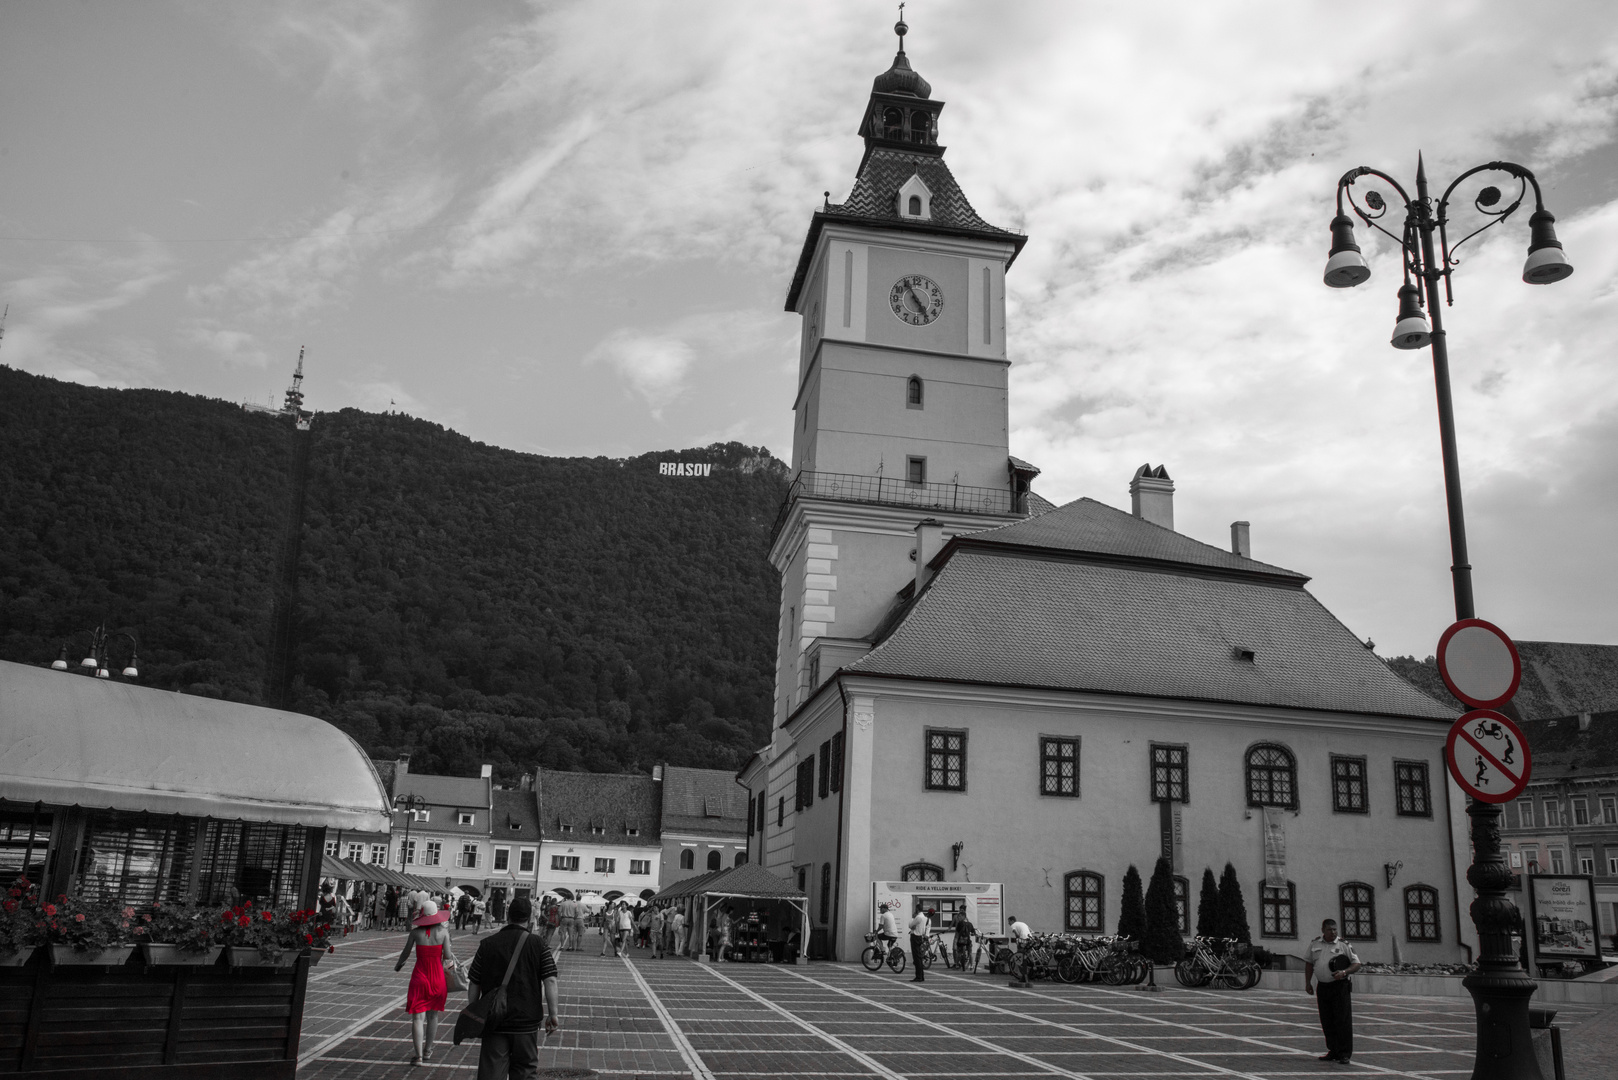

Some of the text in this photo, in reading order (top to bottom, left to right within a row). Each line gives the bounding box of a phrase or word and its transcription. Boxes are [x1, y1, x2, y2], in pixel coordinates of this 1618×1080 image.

[912, 277, 921, 286] 12
[895, 286, 903, 294] 10
[935, 299, 940, 307] 3
[896, 305, 901, 313] 8
[903, 313, 909, 322] 7
[659, 462, 712, 477] BRASOV
[1174, 810, 1182, 845] ISTORIE
